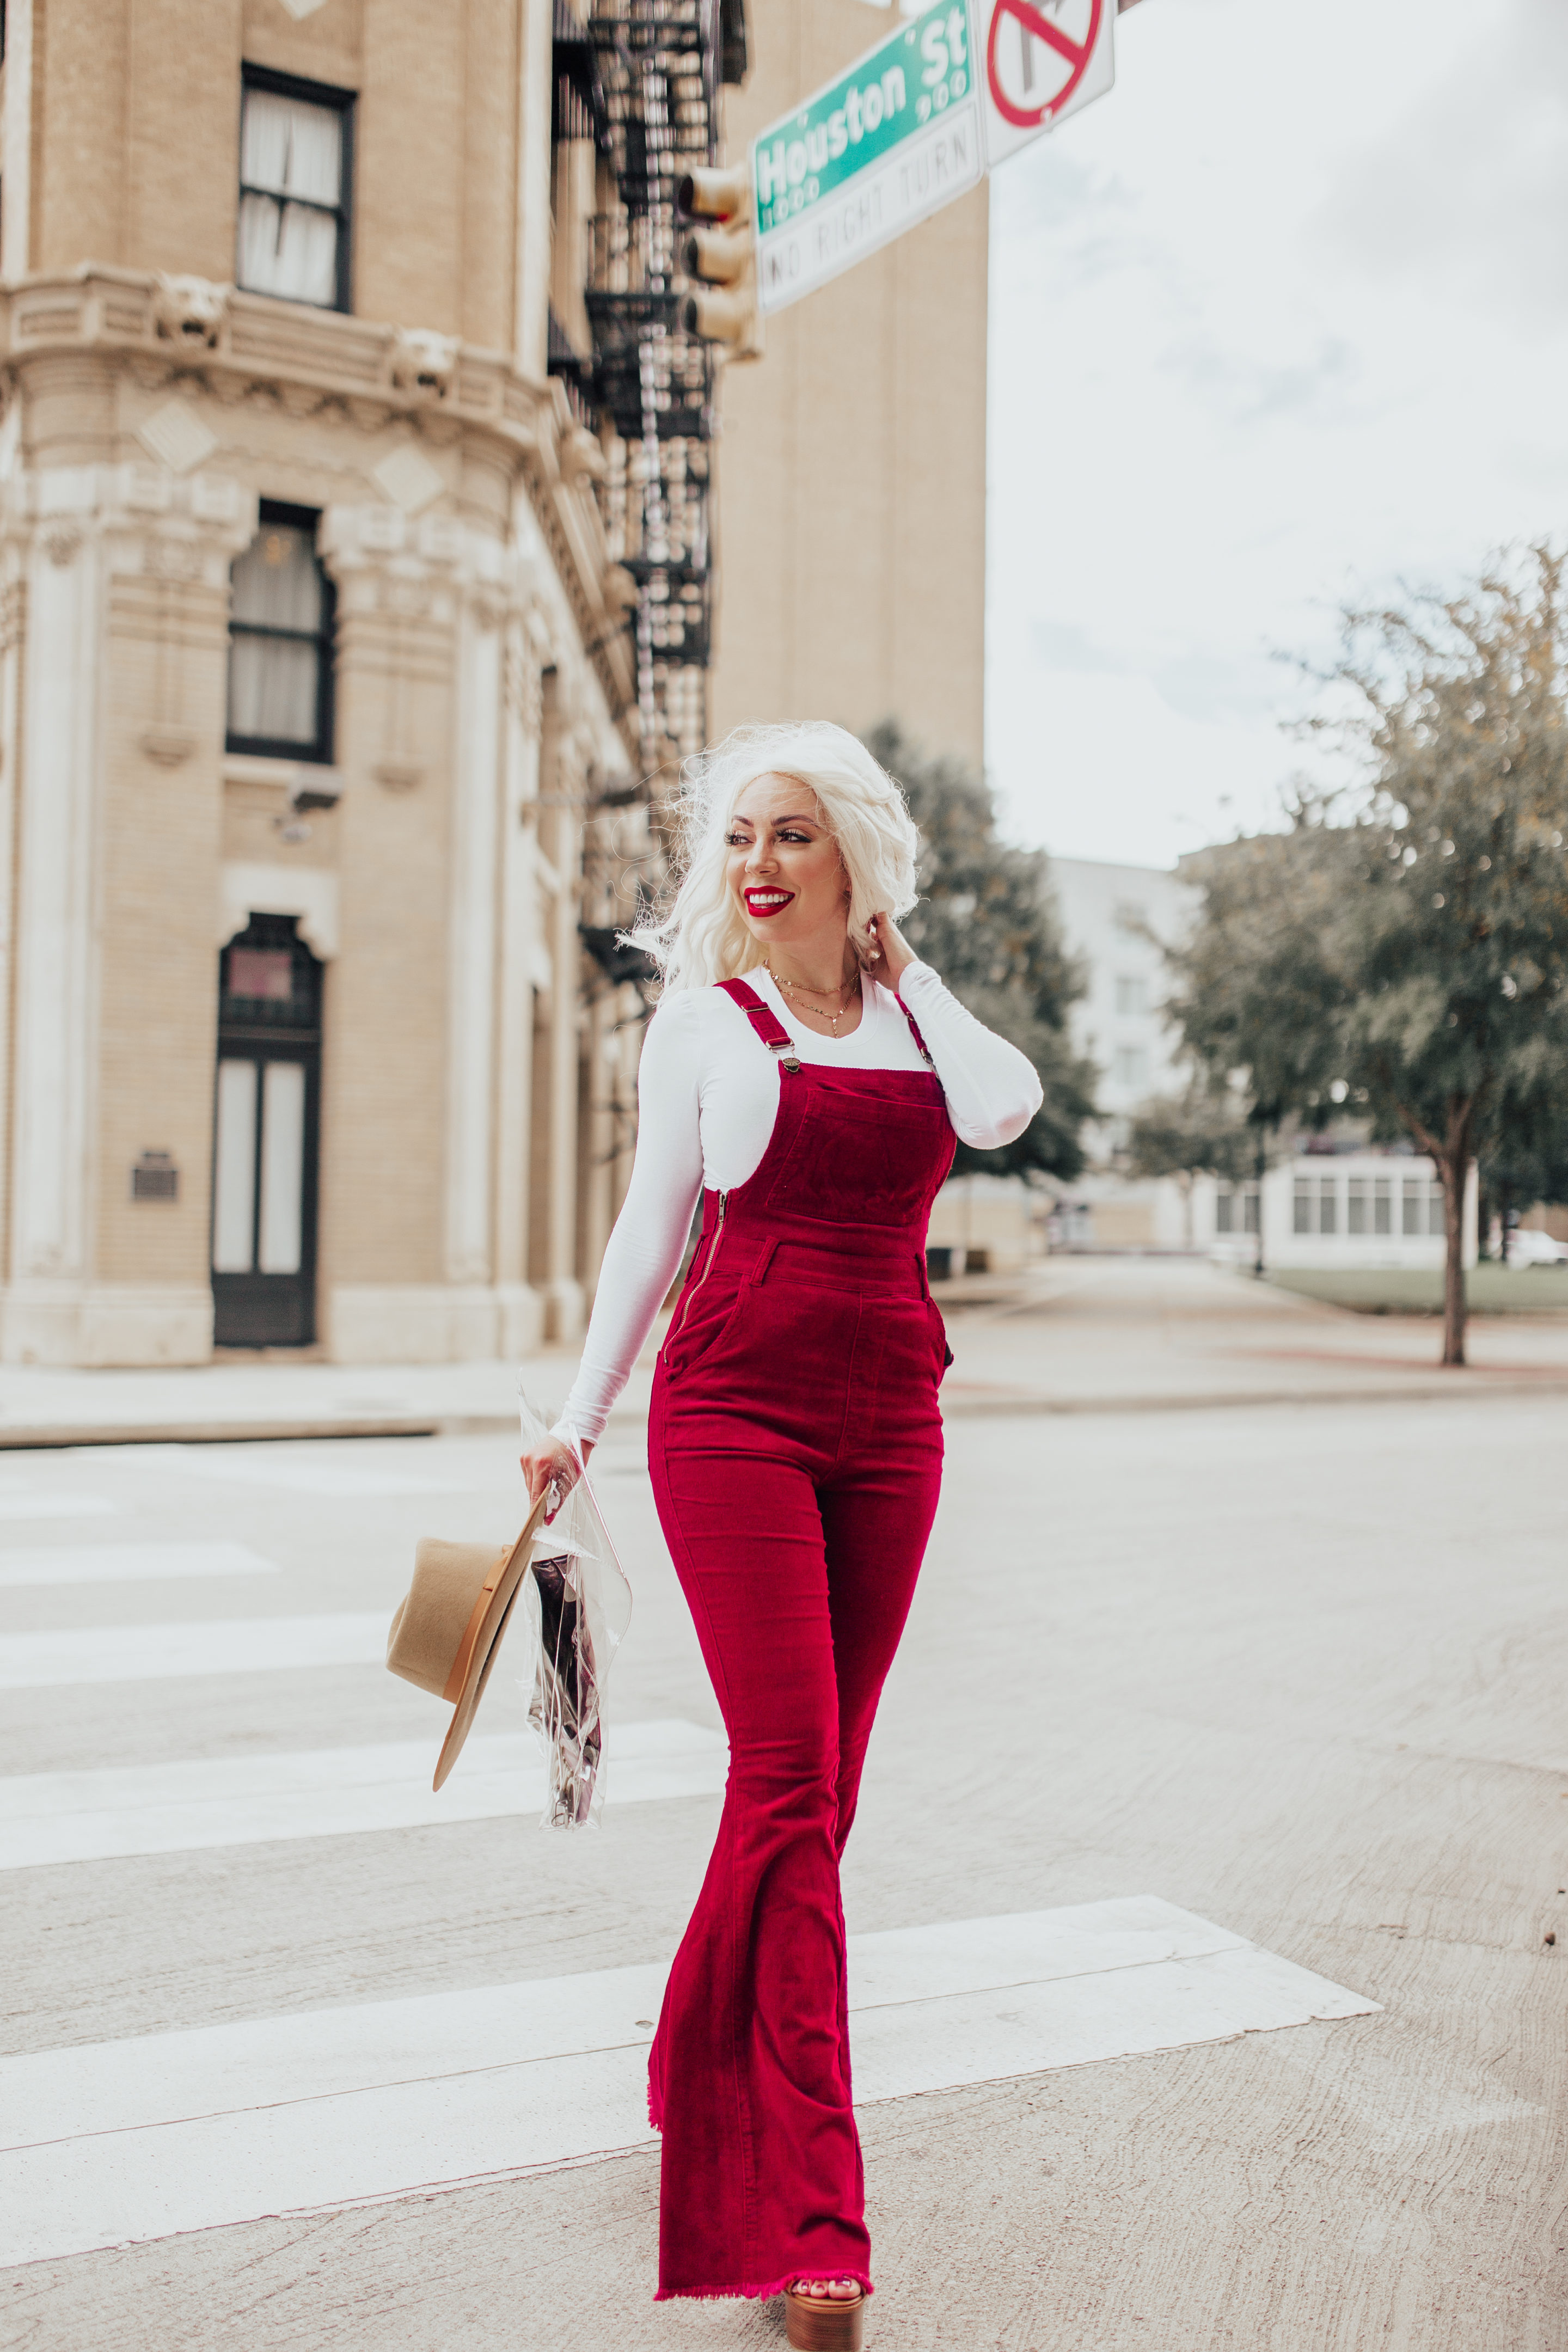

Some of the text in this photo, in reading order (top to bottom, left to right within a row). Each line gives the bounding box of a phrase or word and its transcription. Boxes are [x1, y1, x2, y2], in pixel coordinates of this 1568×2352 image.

[758, 5, 967, 205] Houston St
[915, 69, 967, 124] 900
[762, 176, 819, 231] 1000
[766, 126, 968, 287] NO RIGHT TURN
